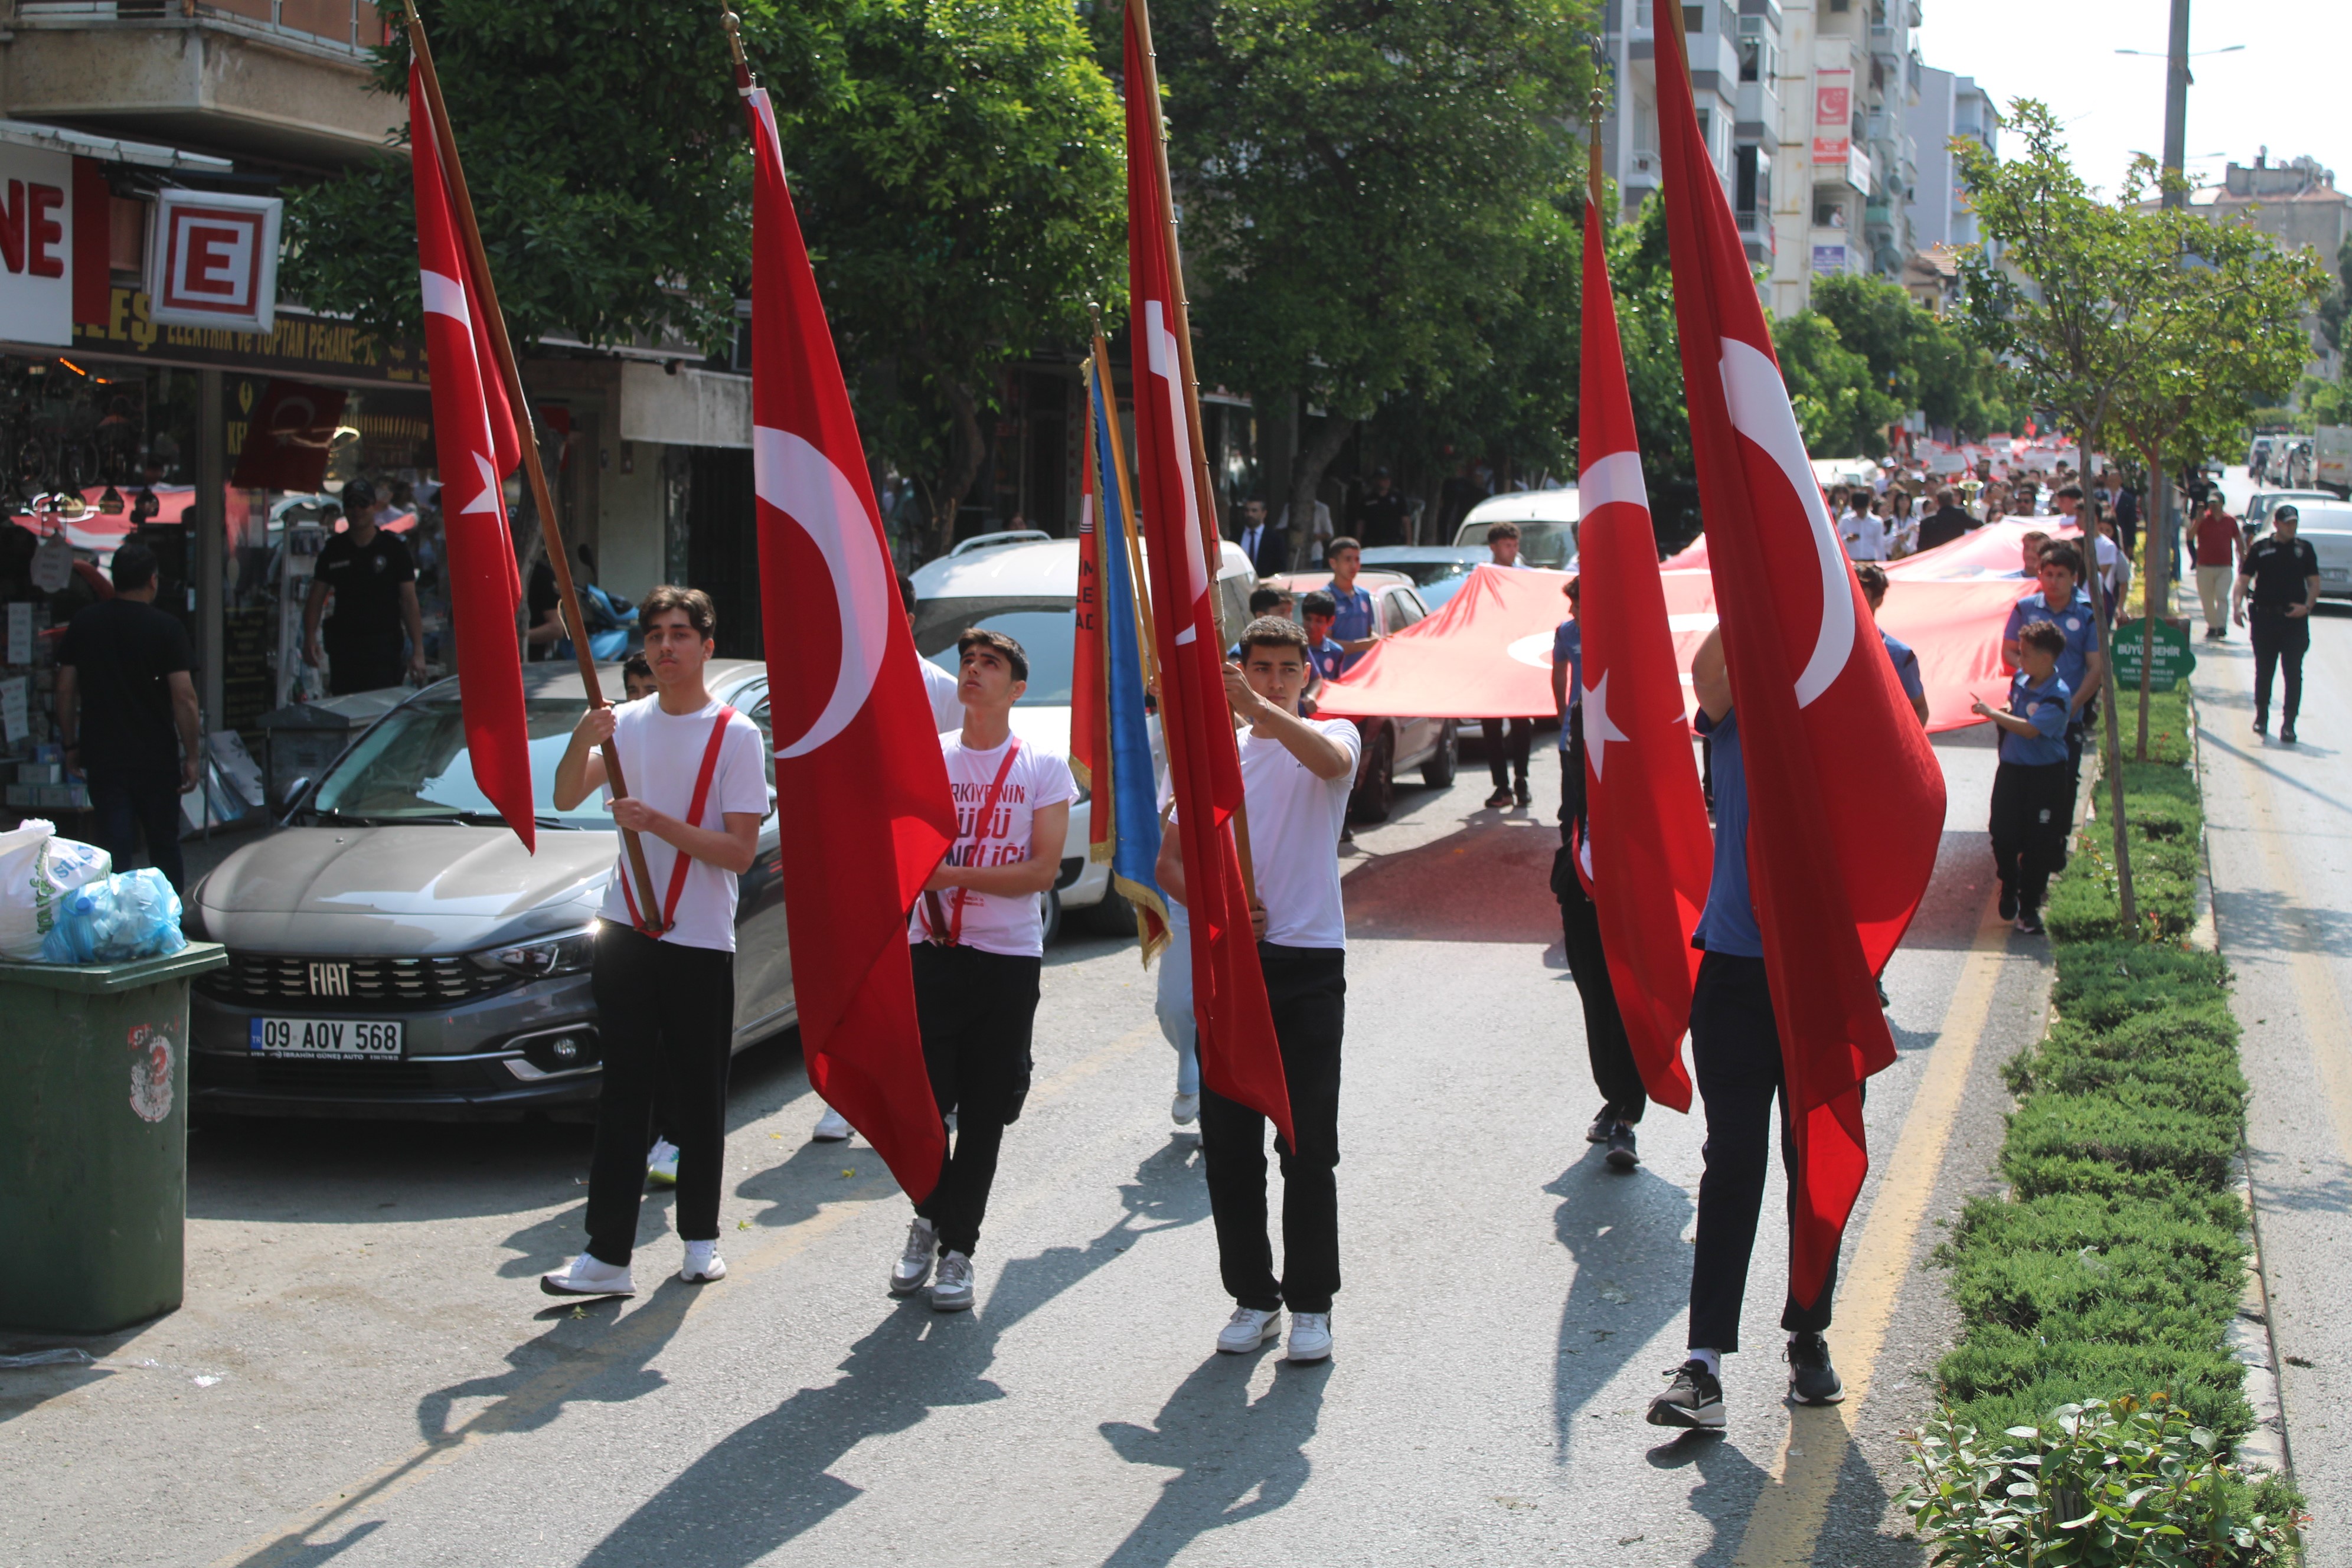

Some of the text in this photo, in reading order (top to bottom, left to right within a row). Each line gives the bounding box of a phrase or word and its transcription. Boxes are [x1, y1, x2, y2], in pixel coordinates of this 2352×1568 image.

[184, 226, 239, 296] E
[2117, 642, 2181, 658] BÜYÜŞEHİR
[957, 808, 1011, 839] ÜCÜ
[309, 962, 350, 996] FIAT
[252, 1035, 262, 1044] TR
[264, 1021, 396, 1050] 09 AOV 568
